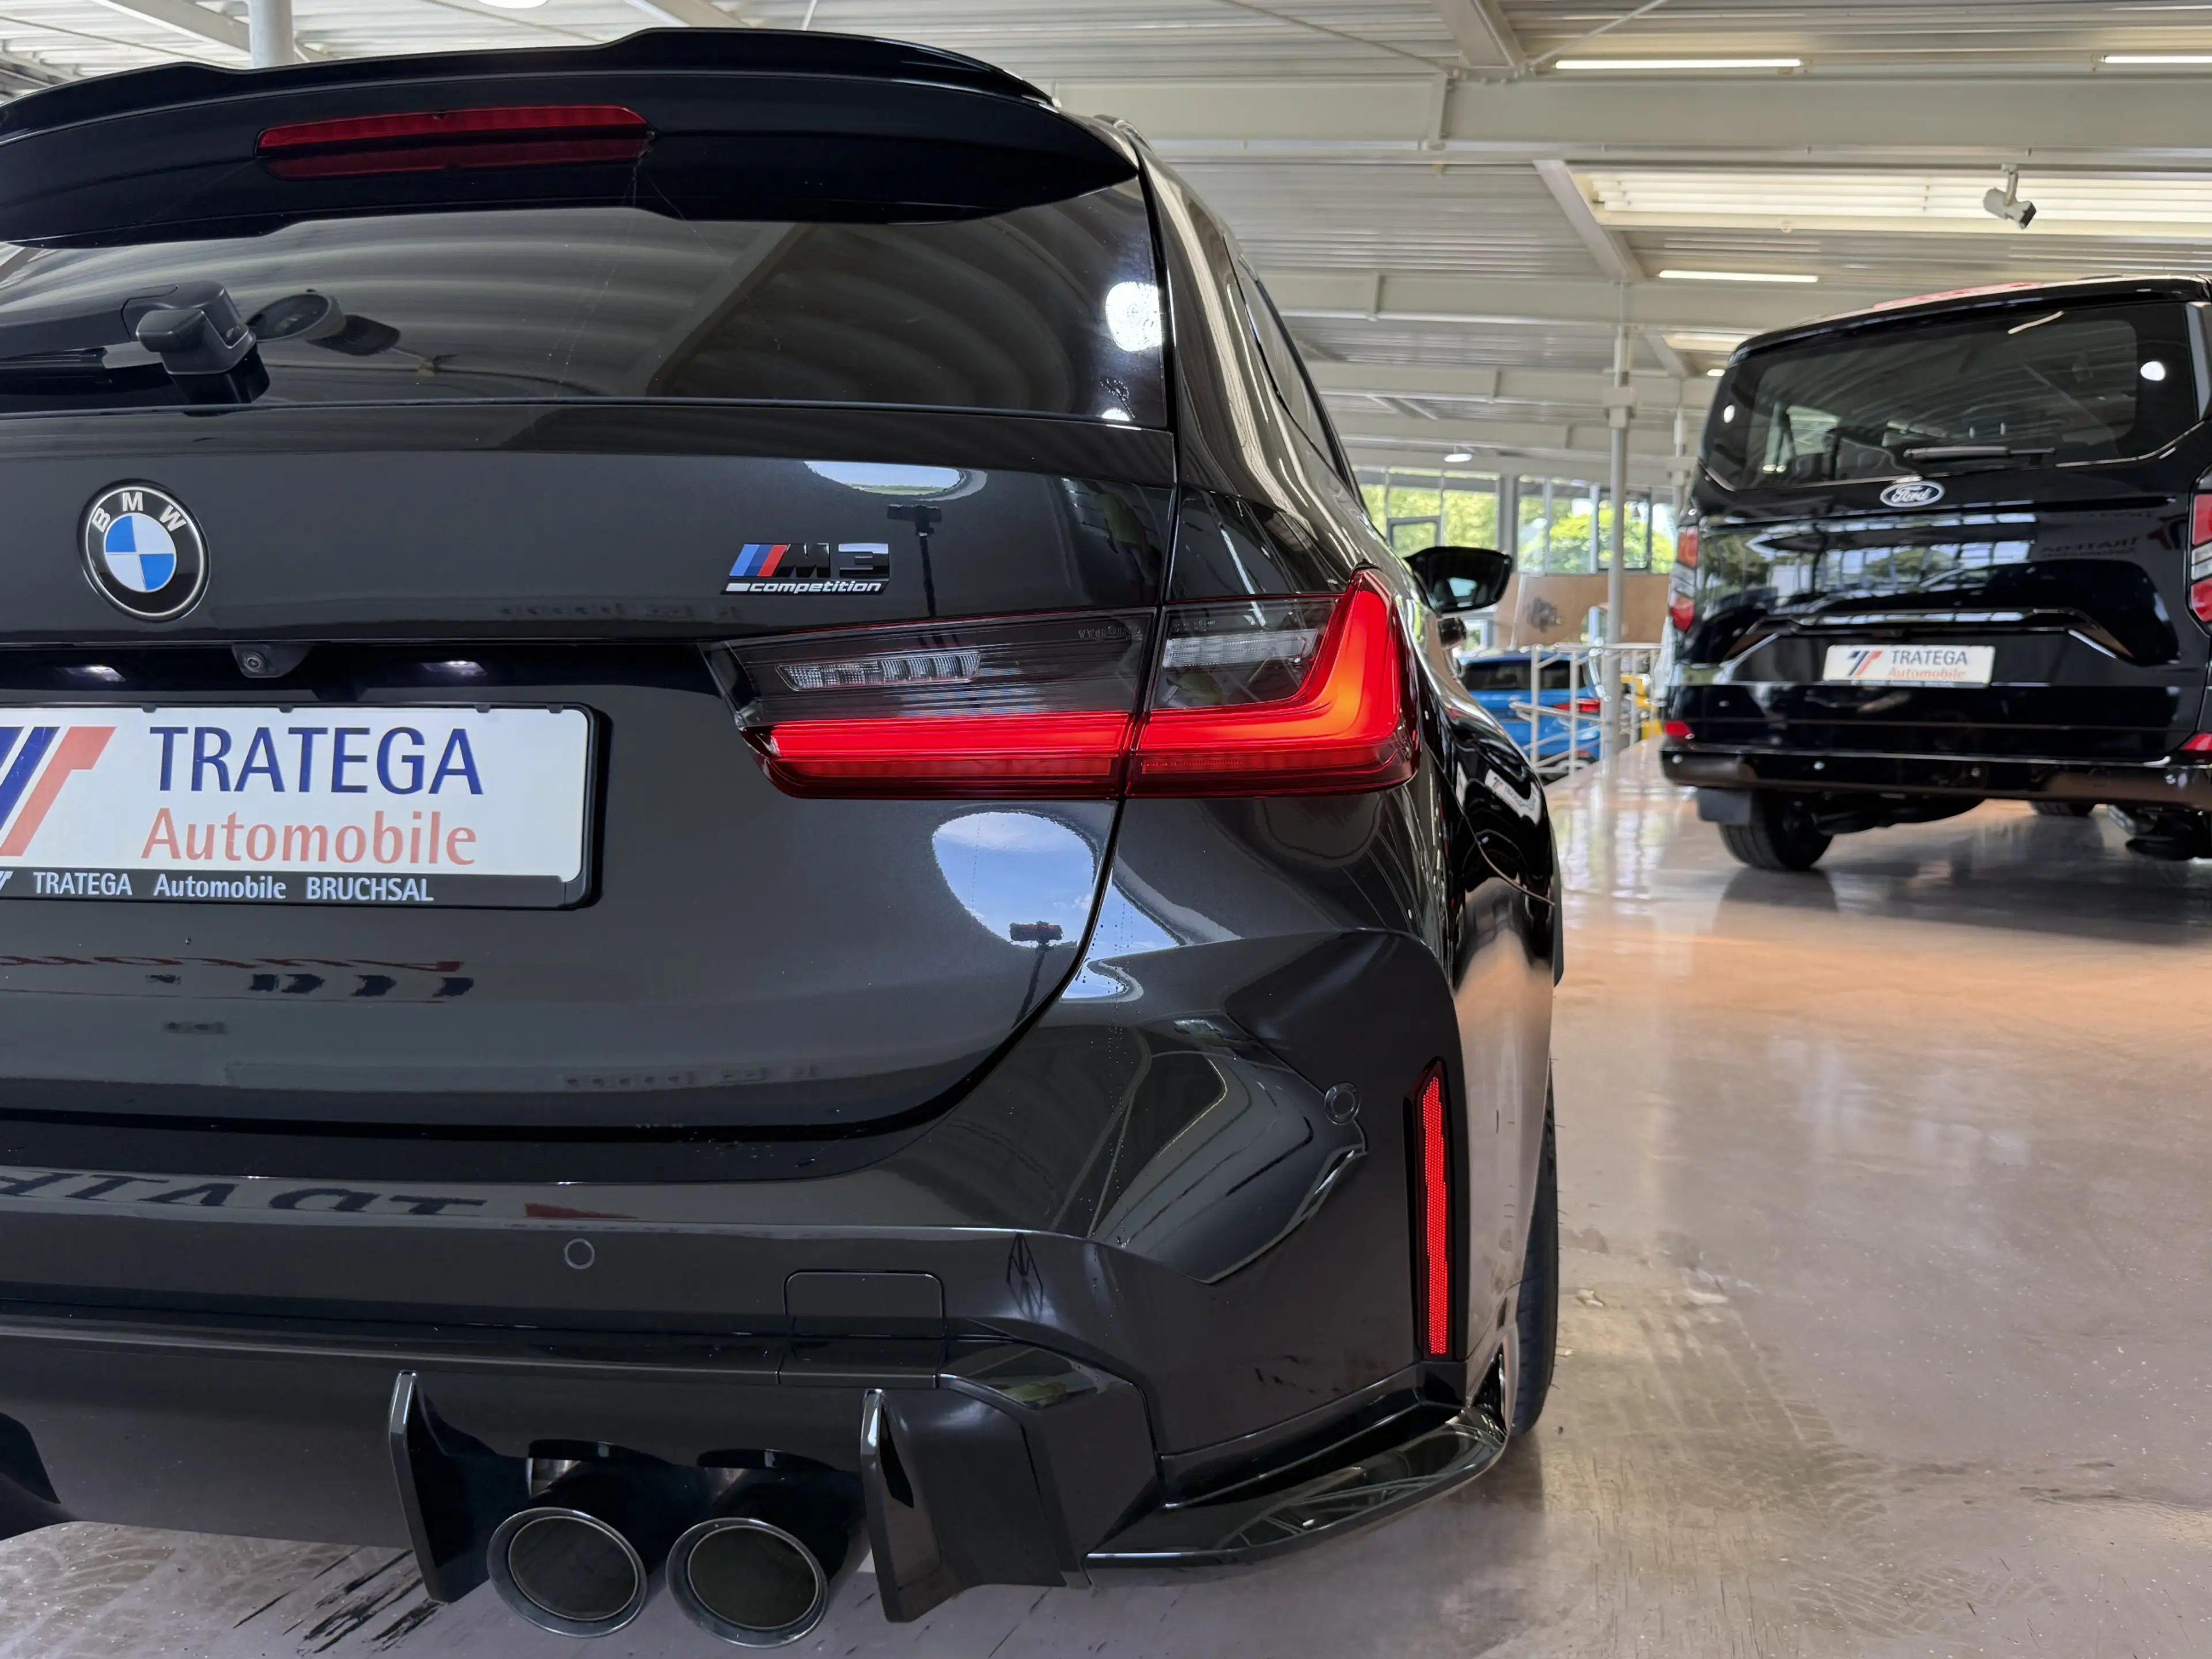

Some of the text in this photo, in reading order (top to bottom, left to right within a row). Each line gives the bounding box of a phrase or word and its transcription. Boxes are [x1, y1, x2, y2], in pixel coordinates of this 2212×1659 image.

[1891, 486, 1933, 503] Ford
[92, 492, 187, 533] BMW
[774, 543, 890, 578] M3
[749, 581, 881, 594] competition
[1888, 666, 1965, 680] Automobile
[1891, 650, 1967, 666] TRATEGA
[149, 726, 483, 795] TRATEGA
[141, 807, 477, 865] Automobile
[33, 872, 434, 902] TRATEGA Automobile BRUCHSAL
